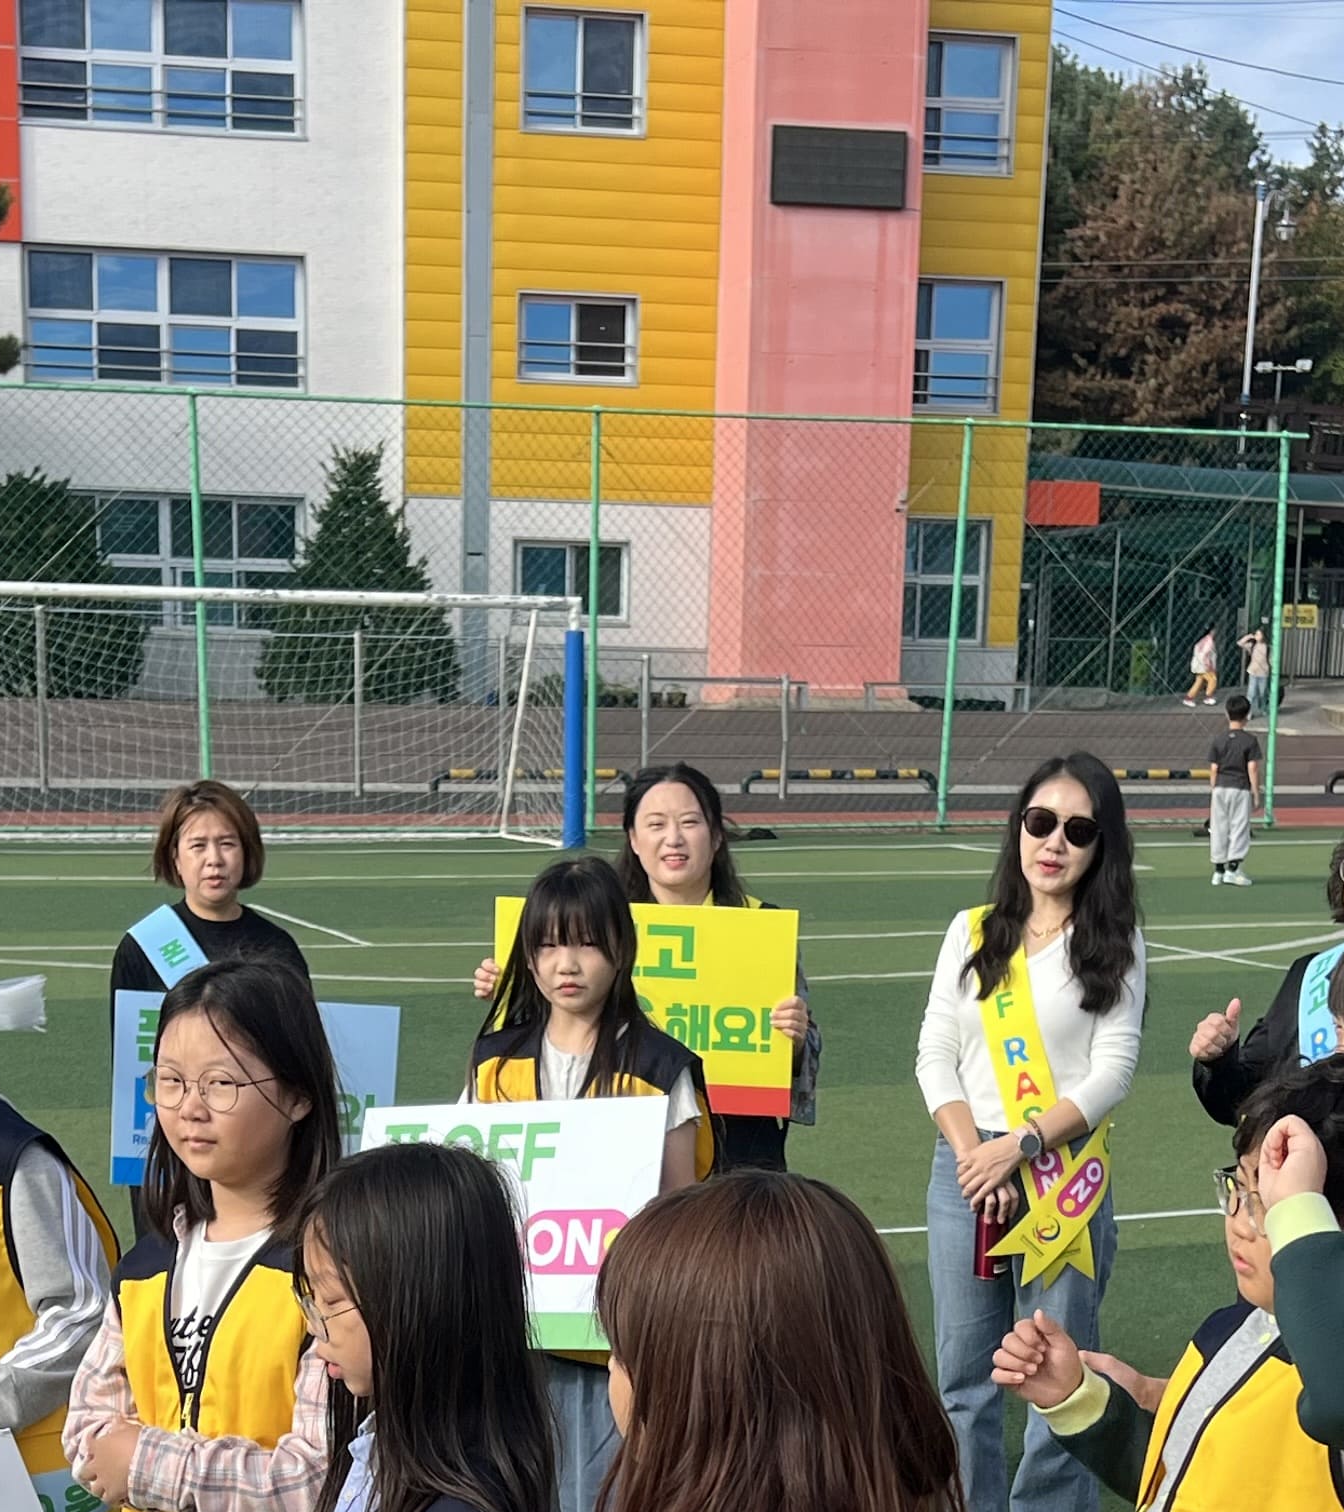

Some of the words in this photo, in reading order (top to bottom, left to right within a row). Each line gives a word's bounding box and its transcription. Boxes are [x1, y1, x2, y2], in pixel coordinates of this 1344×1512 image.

[159, 938, 189, 968] 폰
[633, 924, 696, 980] 고
[1070, 1162, 1102, 1203] ON
[527, 1218, 602, 1267] ON
